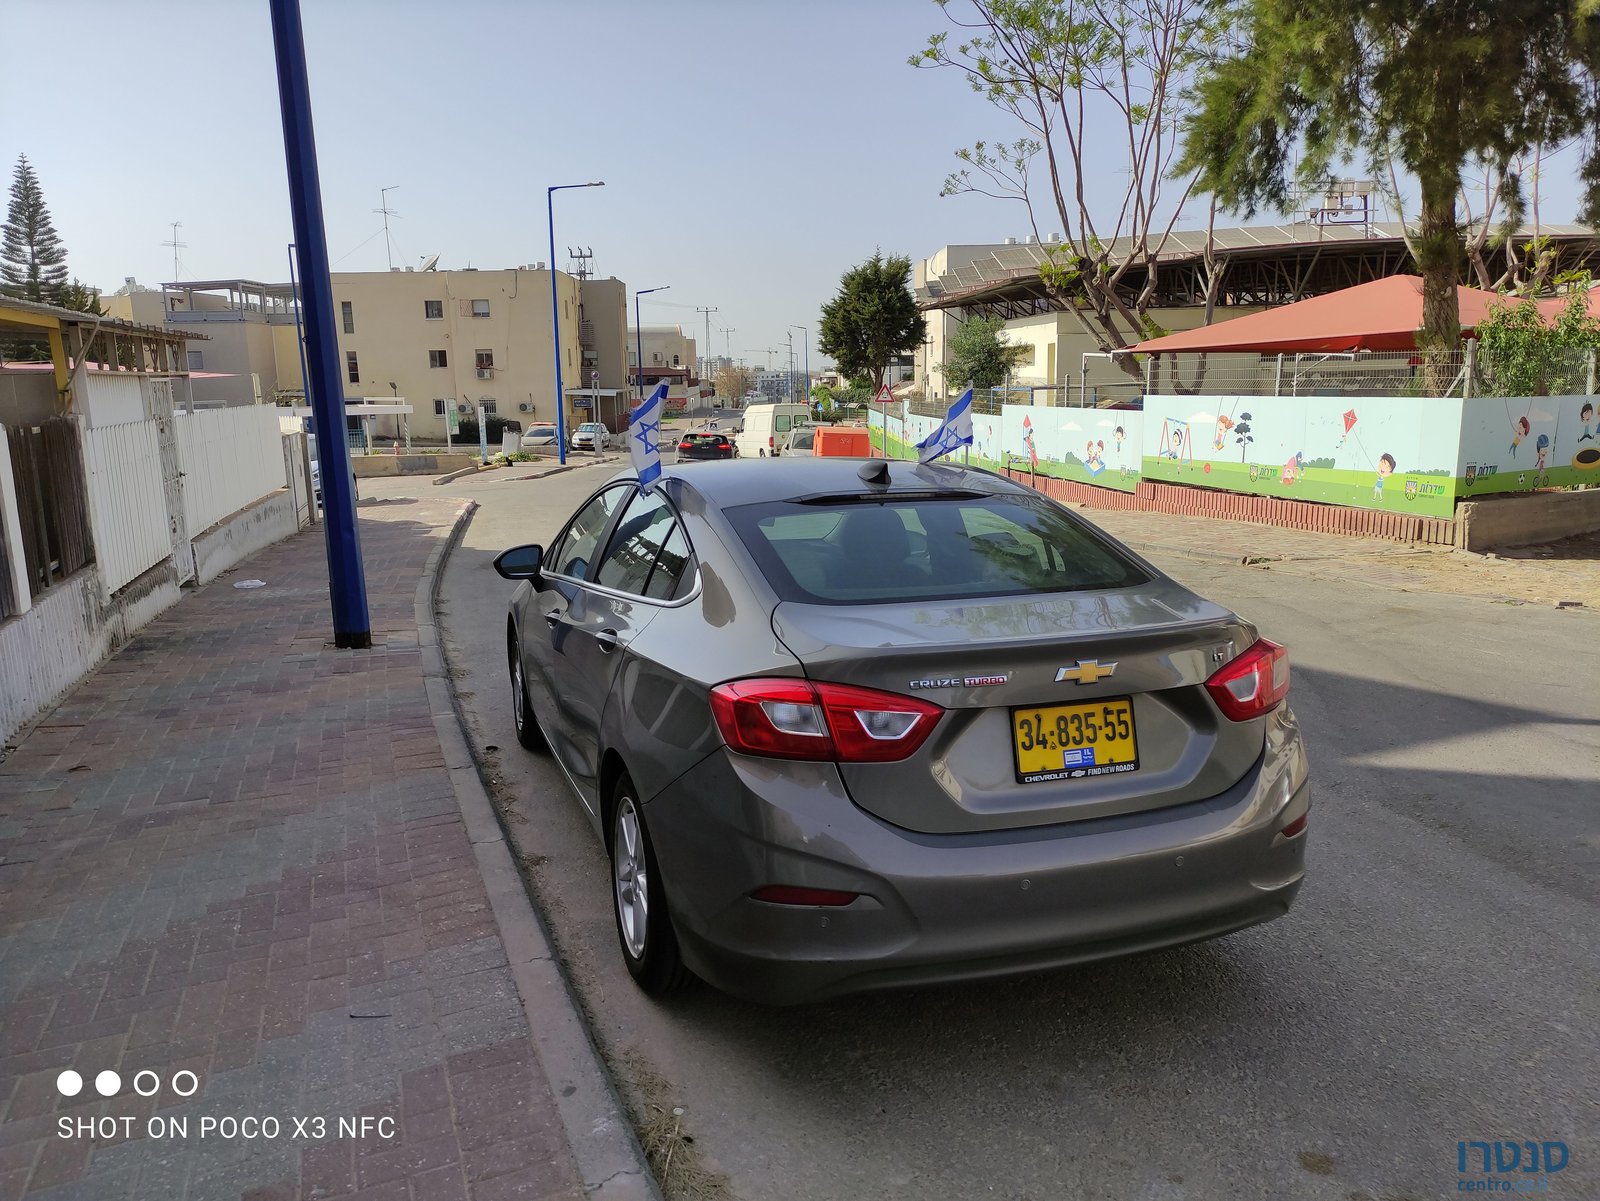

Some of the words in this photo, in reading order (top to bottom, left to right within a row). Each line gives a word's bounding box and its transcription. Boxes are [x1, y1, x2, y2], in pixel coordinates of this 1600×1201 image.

[909, 679, 960, 690] CRUZE
[964, 675, 1007, 688] TURBO
[1024, 770, 1069, 783] CHEVROLET
